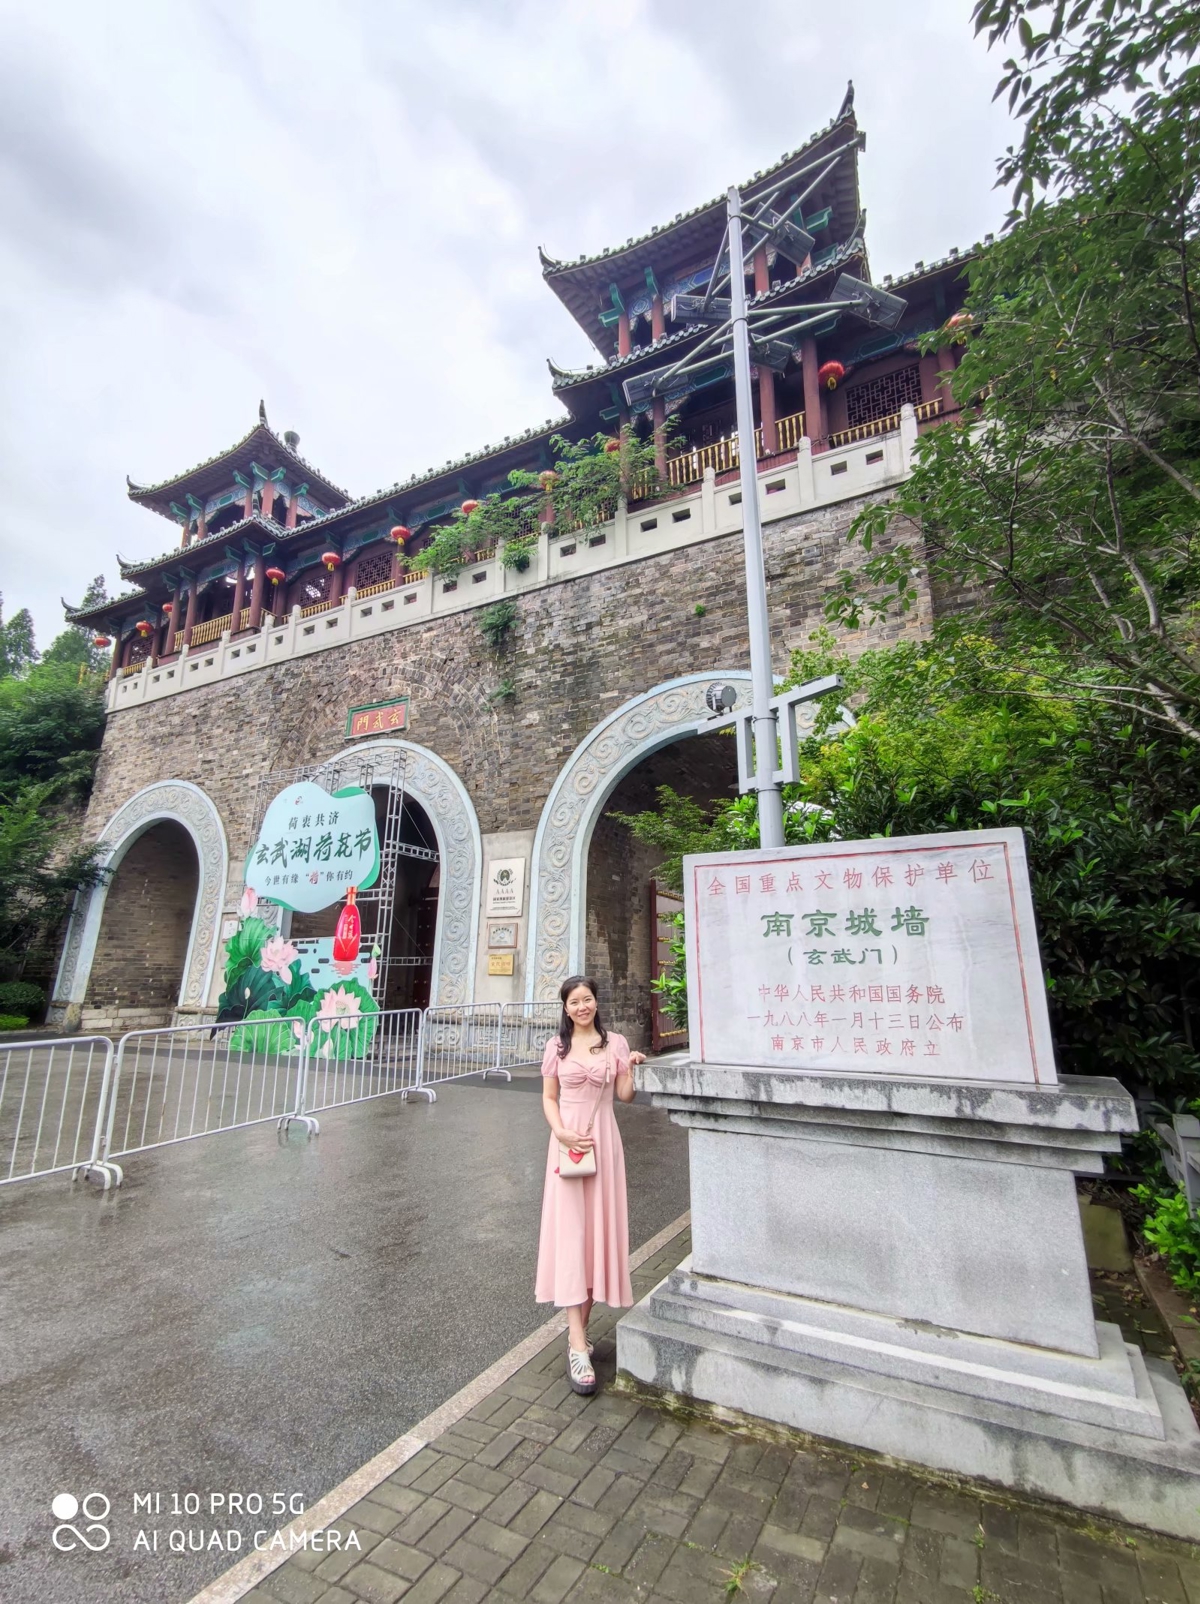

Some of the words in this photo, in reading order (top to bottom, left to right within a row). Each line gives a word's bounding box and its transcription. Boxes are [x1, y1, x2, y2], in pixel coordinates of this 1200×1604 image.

[288, 811, 339, 830] 荷衷共济
[255, 828, 371, 868] 玄武湖荷花节
[707, 858, 995, 896] 全国重点文物保护单位
[760, 905, 930, 938] 南京城墙
[758, 983, 945, 1005] 中华人民共和国国务院
[747, 1010, 964, 1033] 一九八八年一月十三日公布
[771, 1035, 941, 1057] 南京市人民政府立
